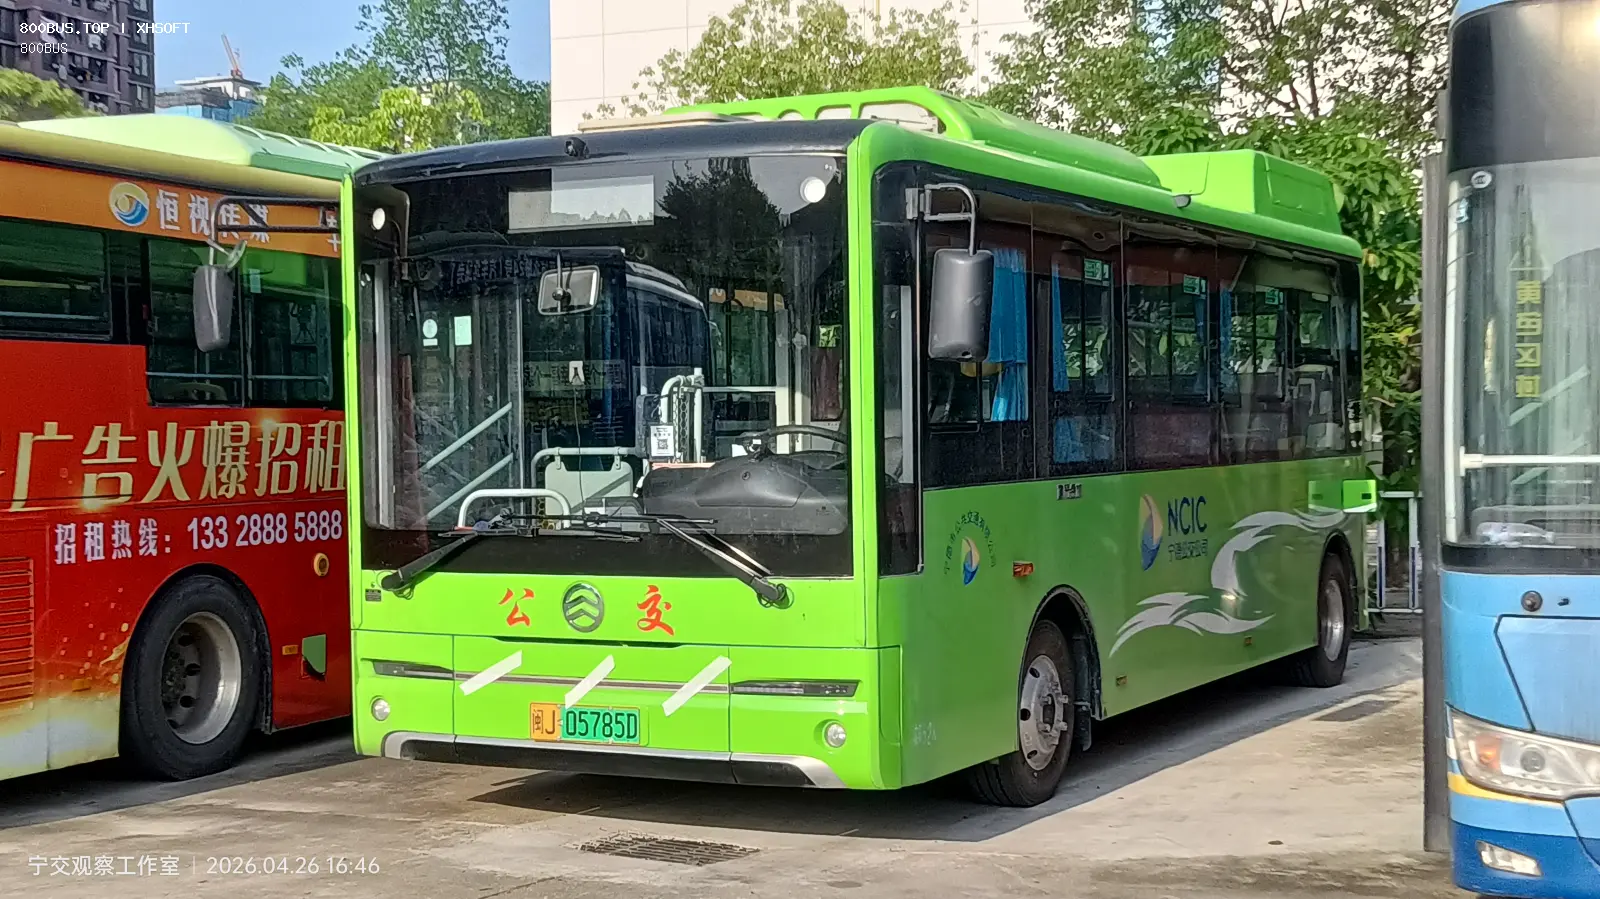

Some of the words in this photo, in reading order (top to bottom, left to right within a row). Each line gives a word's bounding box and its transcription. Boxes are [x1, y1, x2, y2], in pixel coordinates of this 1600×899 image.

[9, 420, 346, 512] 广告火爆招租
[187, 515, 229, 550] 133
[235, 512, 288, 547] 2888
[294, 509, 343, 542] 5888
[1167, 495, 1208, 537] NCIC
[498, 587, 535, 627] 公
[636, 584, 675, 636] 交
[565, 710, 638, 739] 05785D
